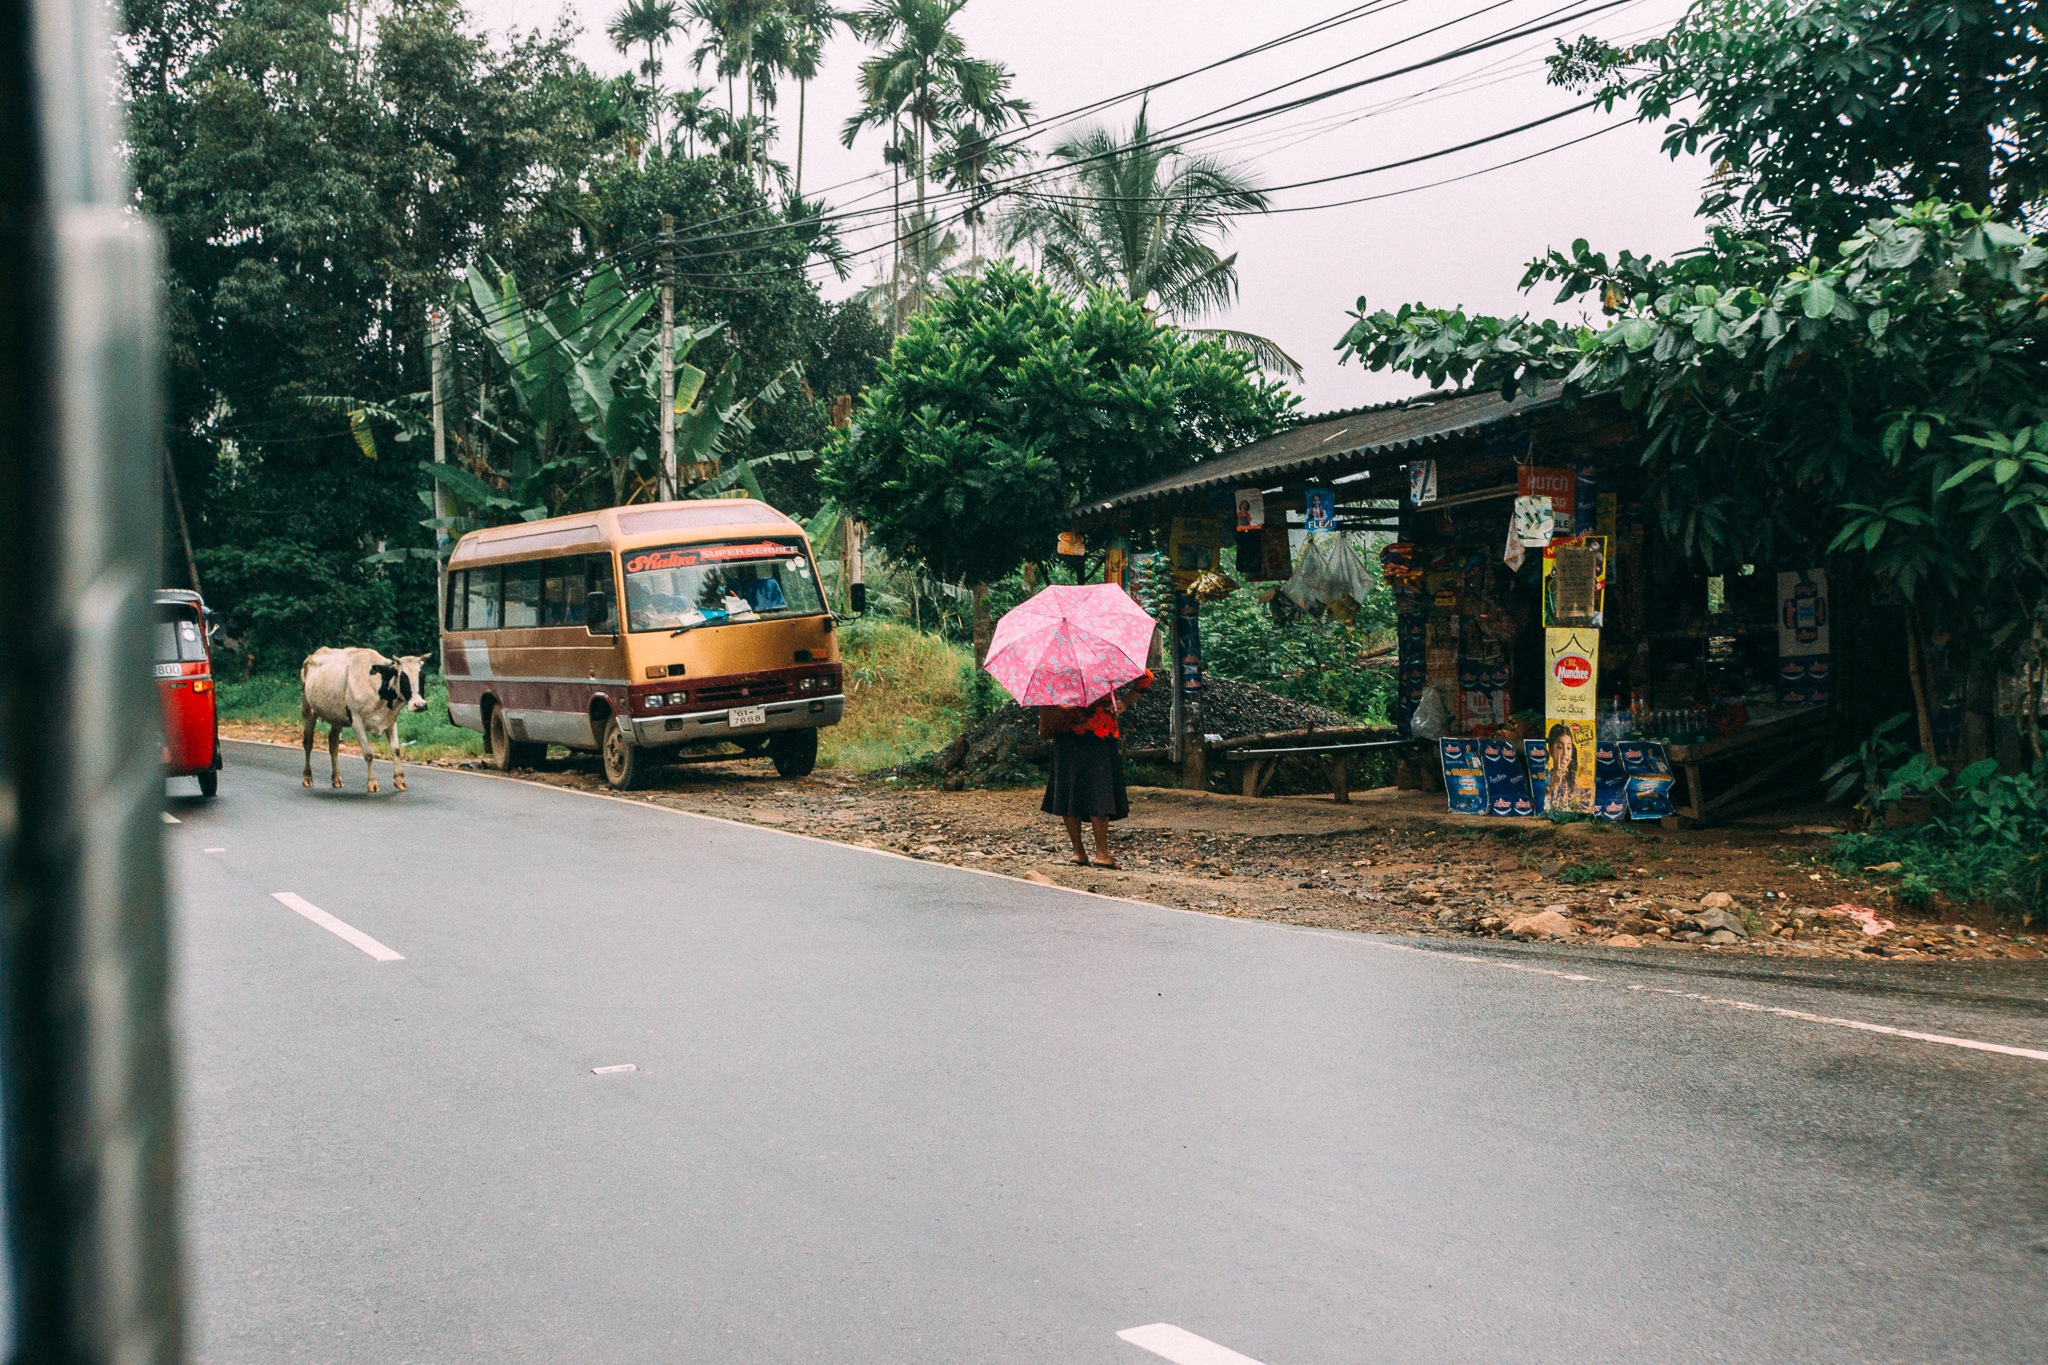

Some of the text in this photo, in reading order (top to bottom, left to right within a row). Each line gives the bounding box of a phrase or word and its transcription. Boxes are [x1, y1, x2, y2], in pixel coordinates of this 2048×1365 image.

[702, 545, 799, 559] SUPER SERVICE
[1556, 666, 1588, 680] Munchee
